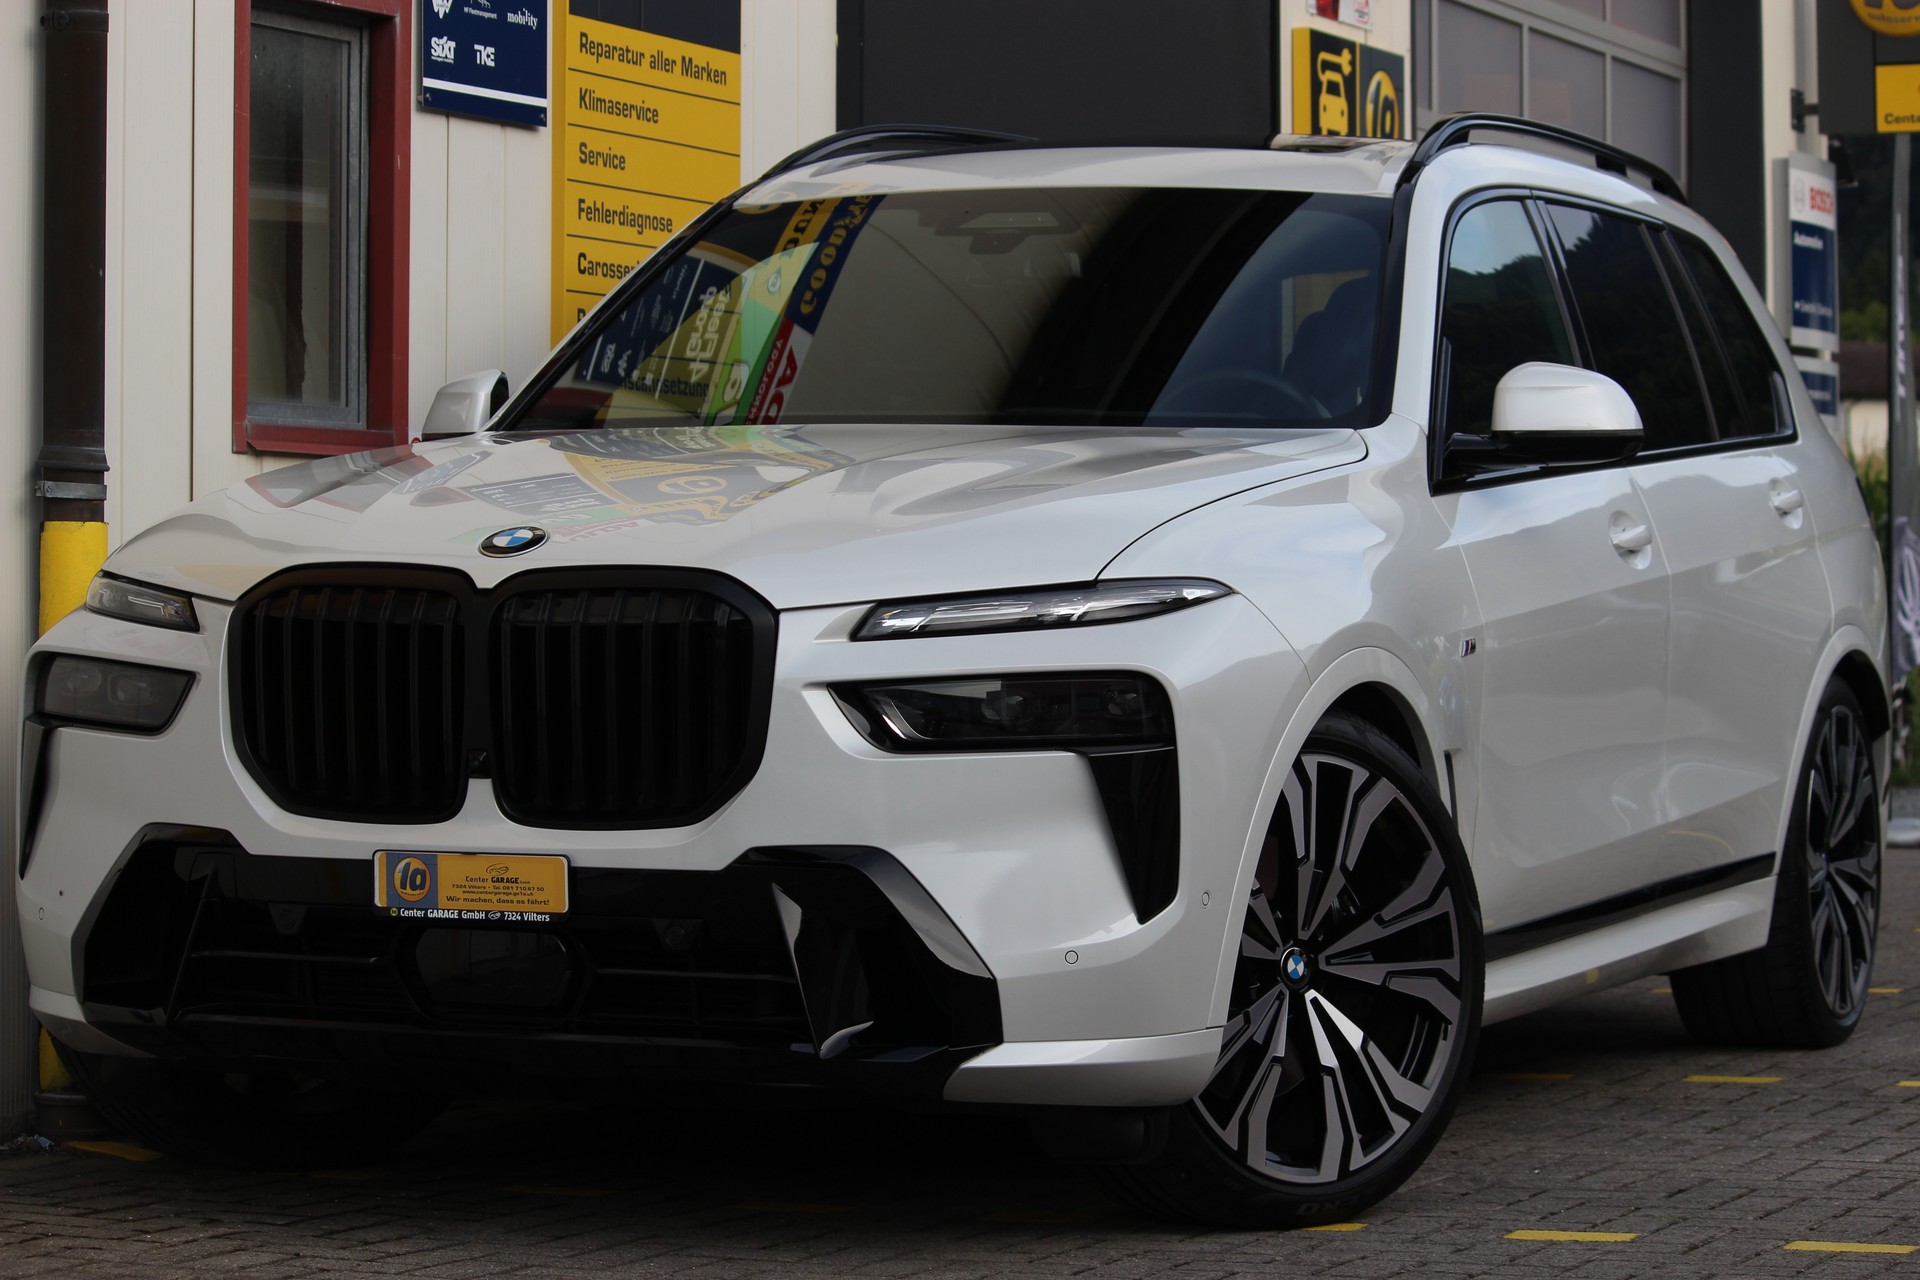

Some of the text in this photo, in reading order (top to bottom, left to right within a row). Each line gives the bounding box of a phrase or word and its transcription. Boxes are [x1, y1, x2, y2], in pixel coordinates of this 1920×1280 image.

[507, 8, 538, 30] mobility
[579, 32, 728, 86] Reparatur aller Marken
[579, 87, 659, 124] Klimaservice
[578, 142, 626, 171] Service
[578, 199, 673, 235] Fehlerdiagnose
[577, 252, 640, 280] Carosse
[491, 876, 519, 884] GARAGE
[400, 908, 550, 922] Center GARAGE GmbH 7324 Vilters
